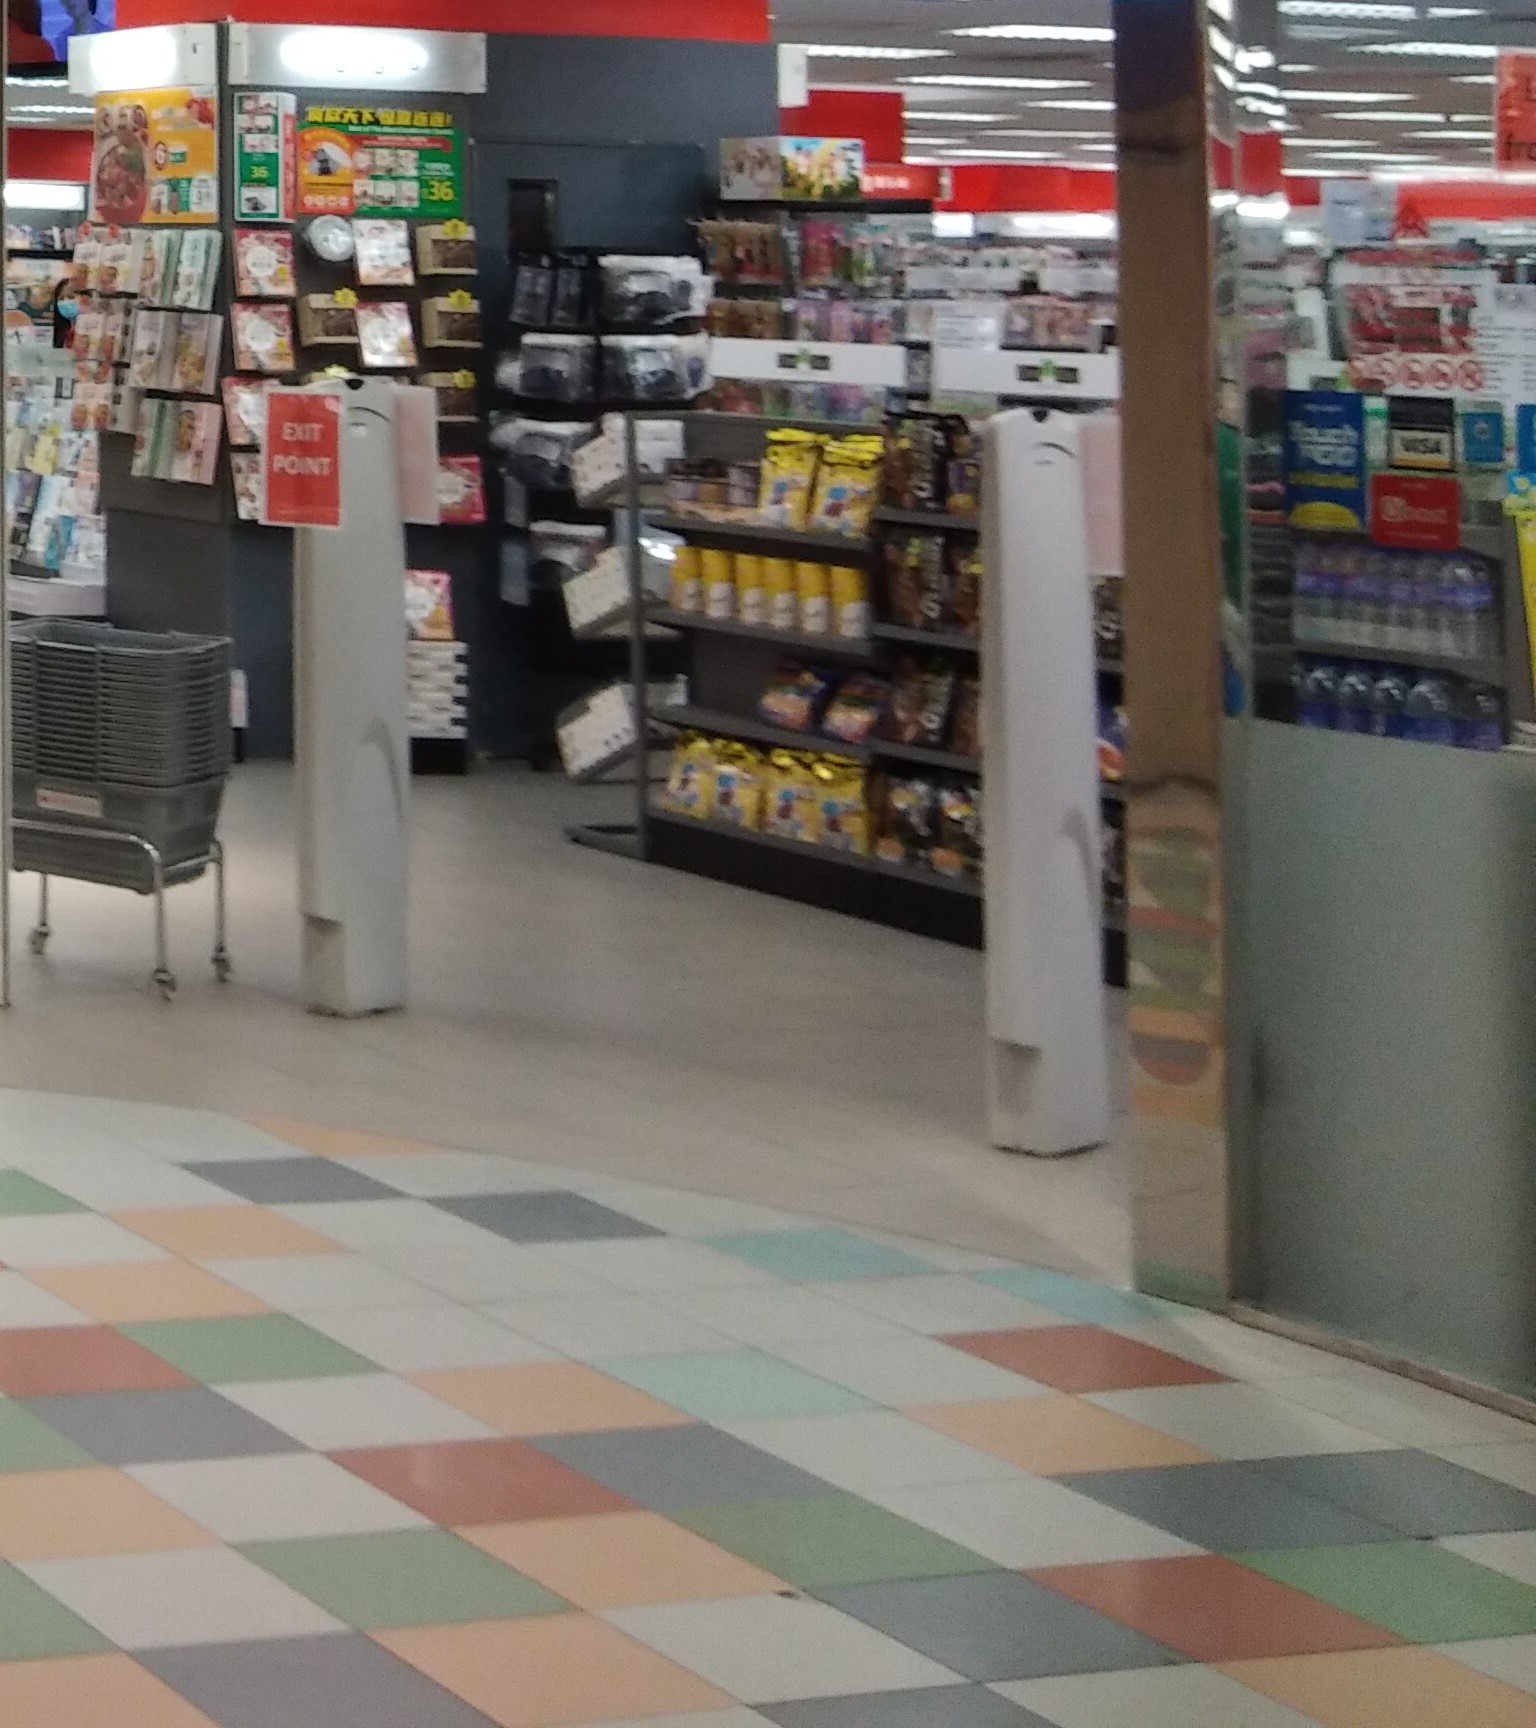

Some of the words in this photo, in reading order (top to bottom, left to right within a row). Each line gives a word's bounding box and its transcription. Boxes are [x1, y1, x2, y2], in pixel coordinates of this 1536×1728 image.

[282, 422, 326, 443] EXIT
[1399, 436, 1443, 455] VISA
[271, 454, 332, 478] POINT
